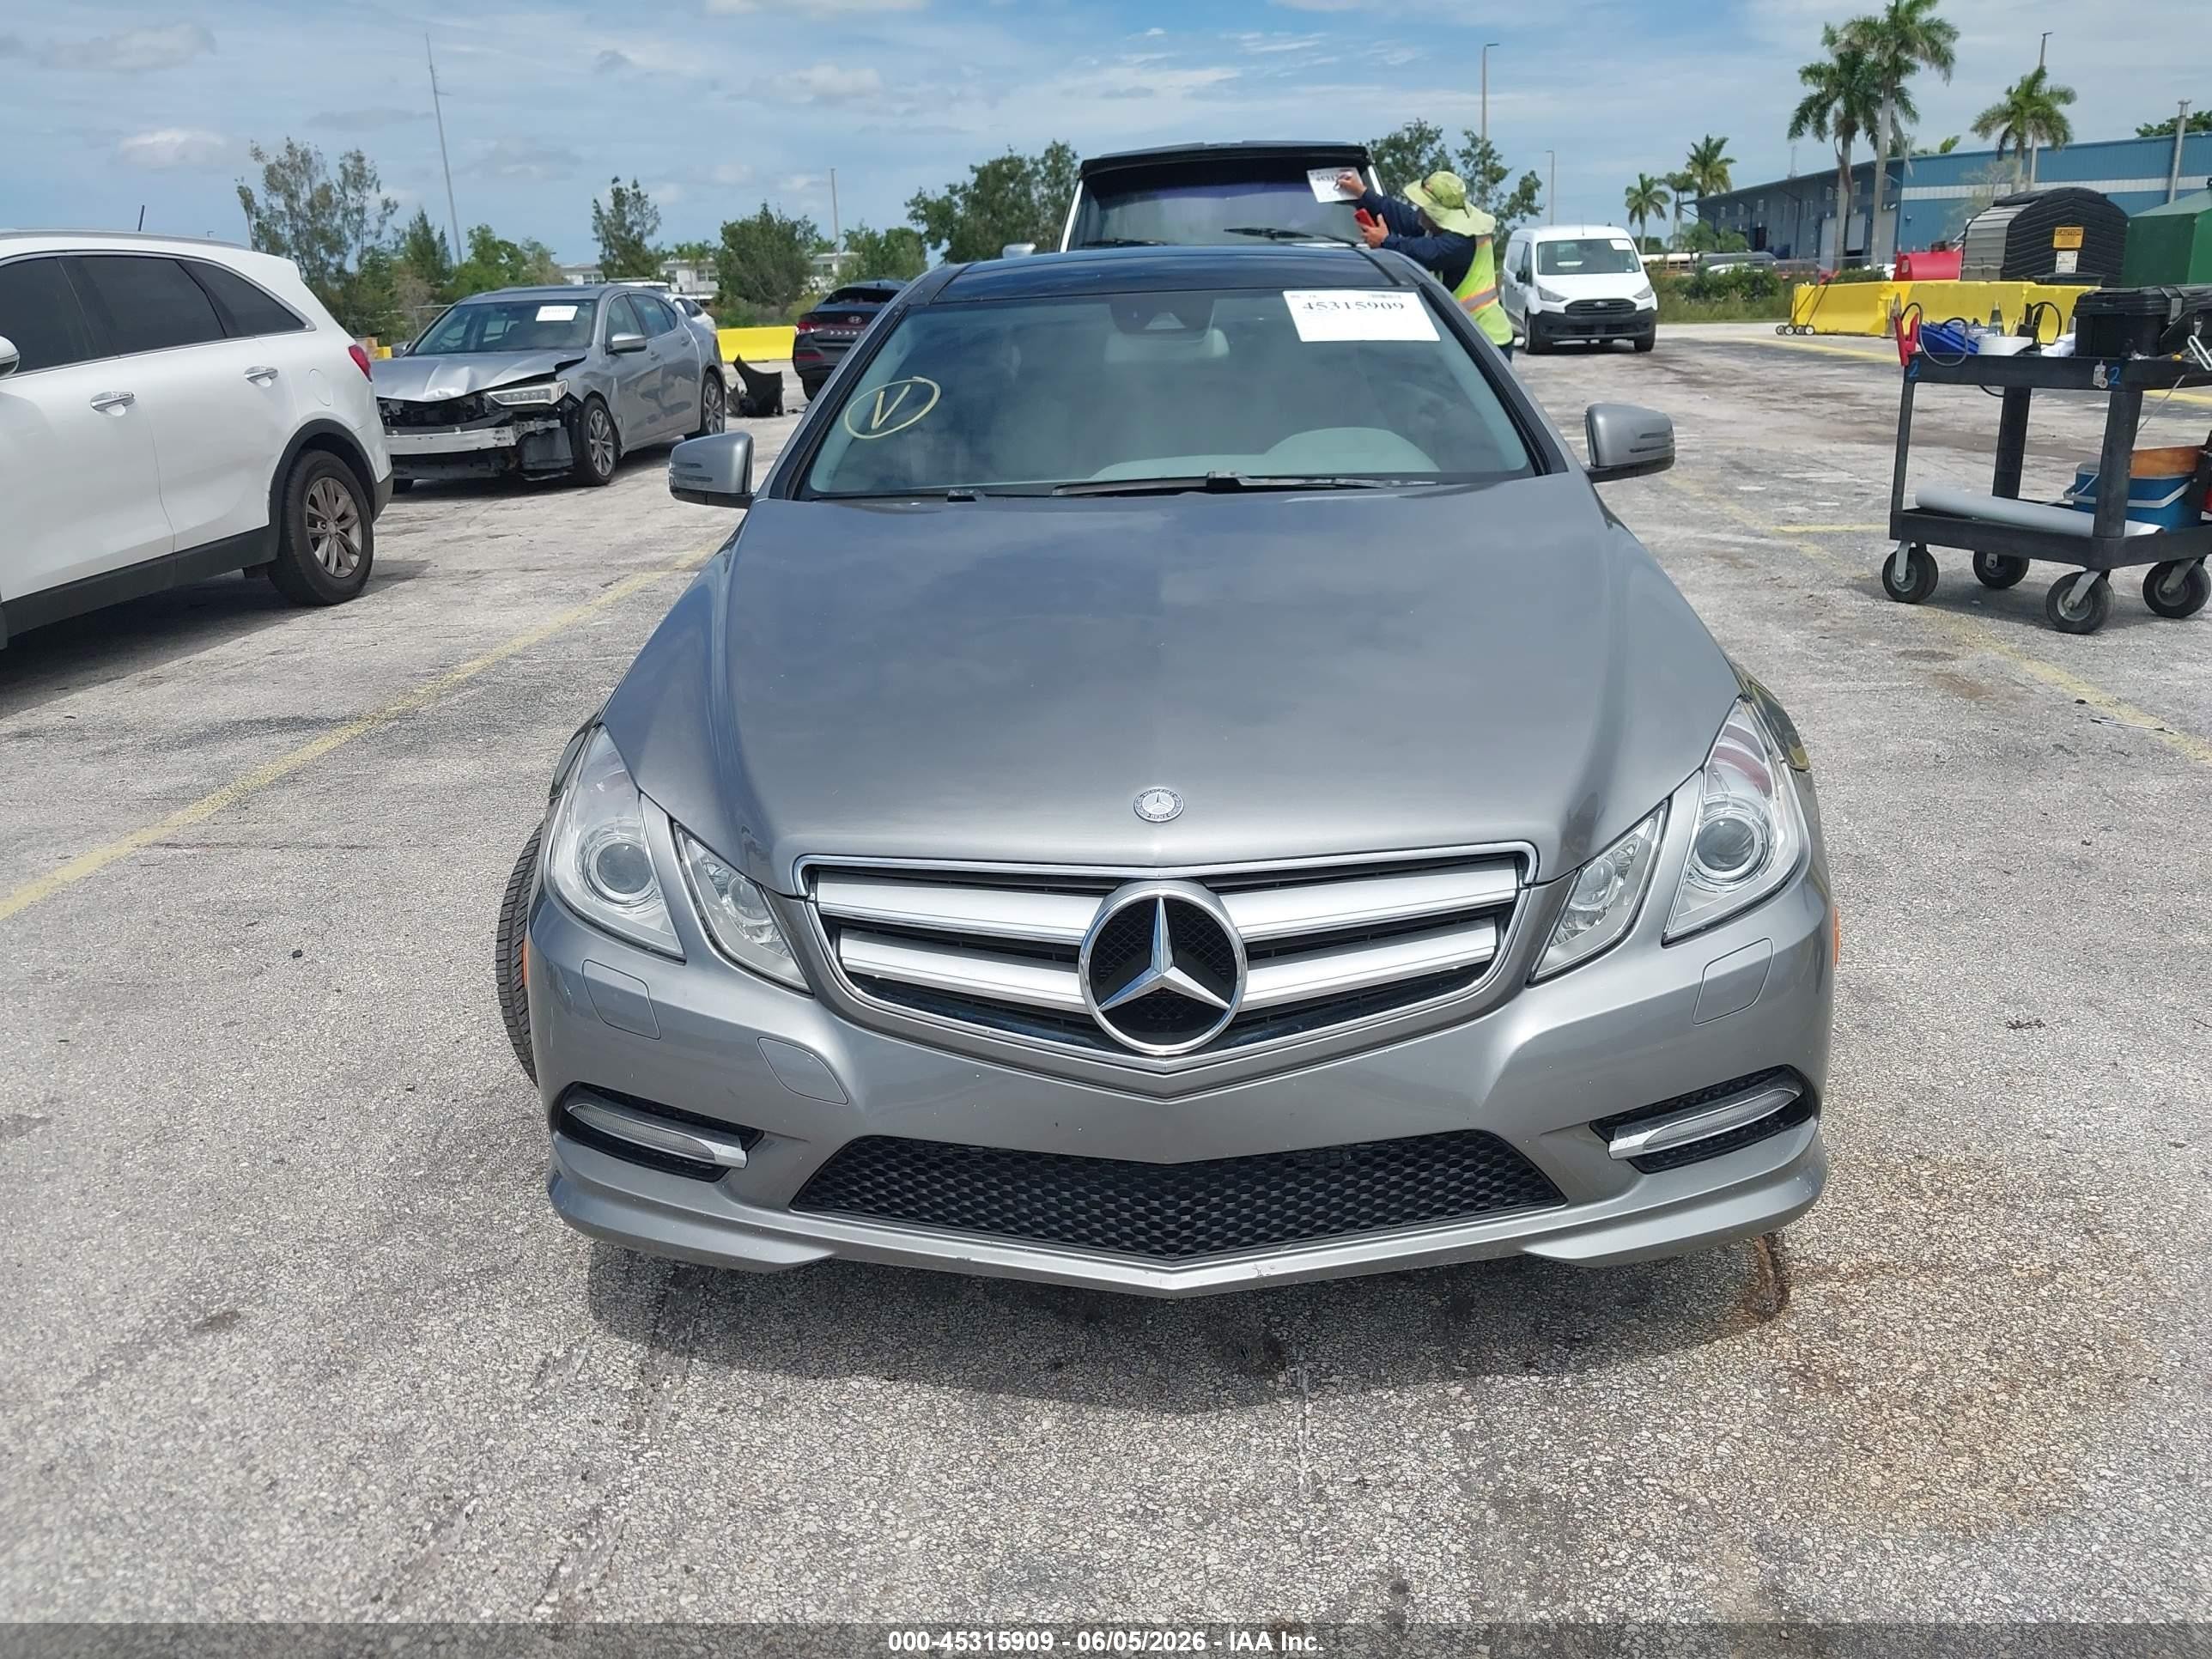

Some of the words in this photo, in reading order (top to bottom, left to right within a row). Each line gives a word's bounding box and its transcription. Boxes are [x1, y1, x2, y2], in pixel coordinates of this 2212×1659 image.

[1302, 301, 1406, 311] 45315909
[1907, 359, 1920, 378] 2
[2109, 366, 2121, 385] 2
